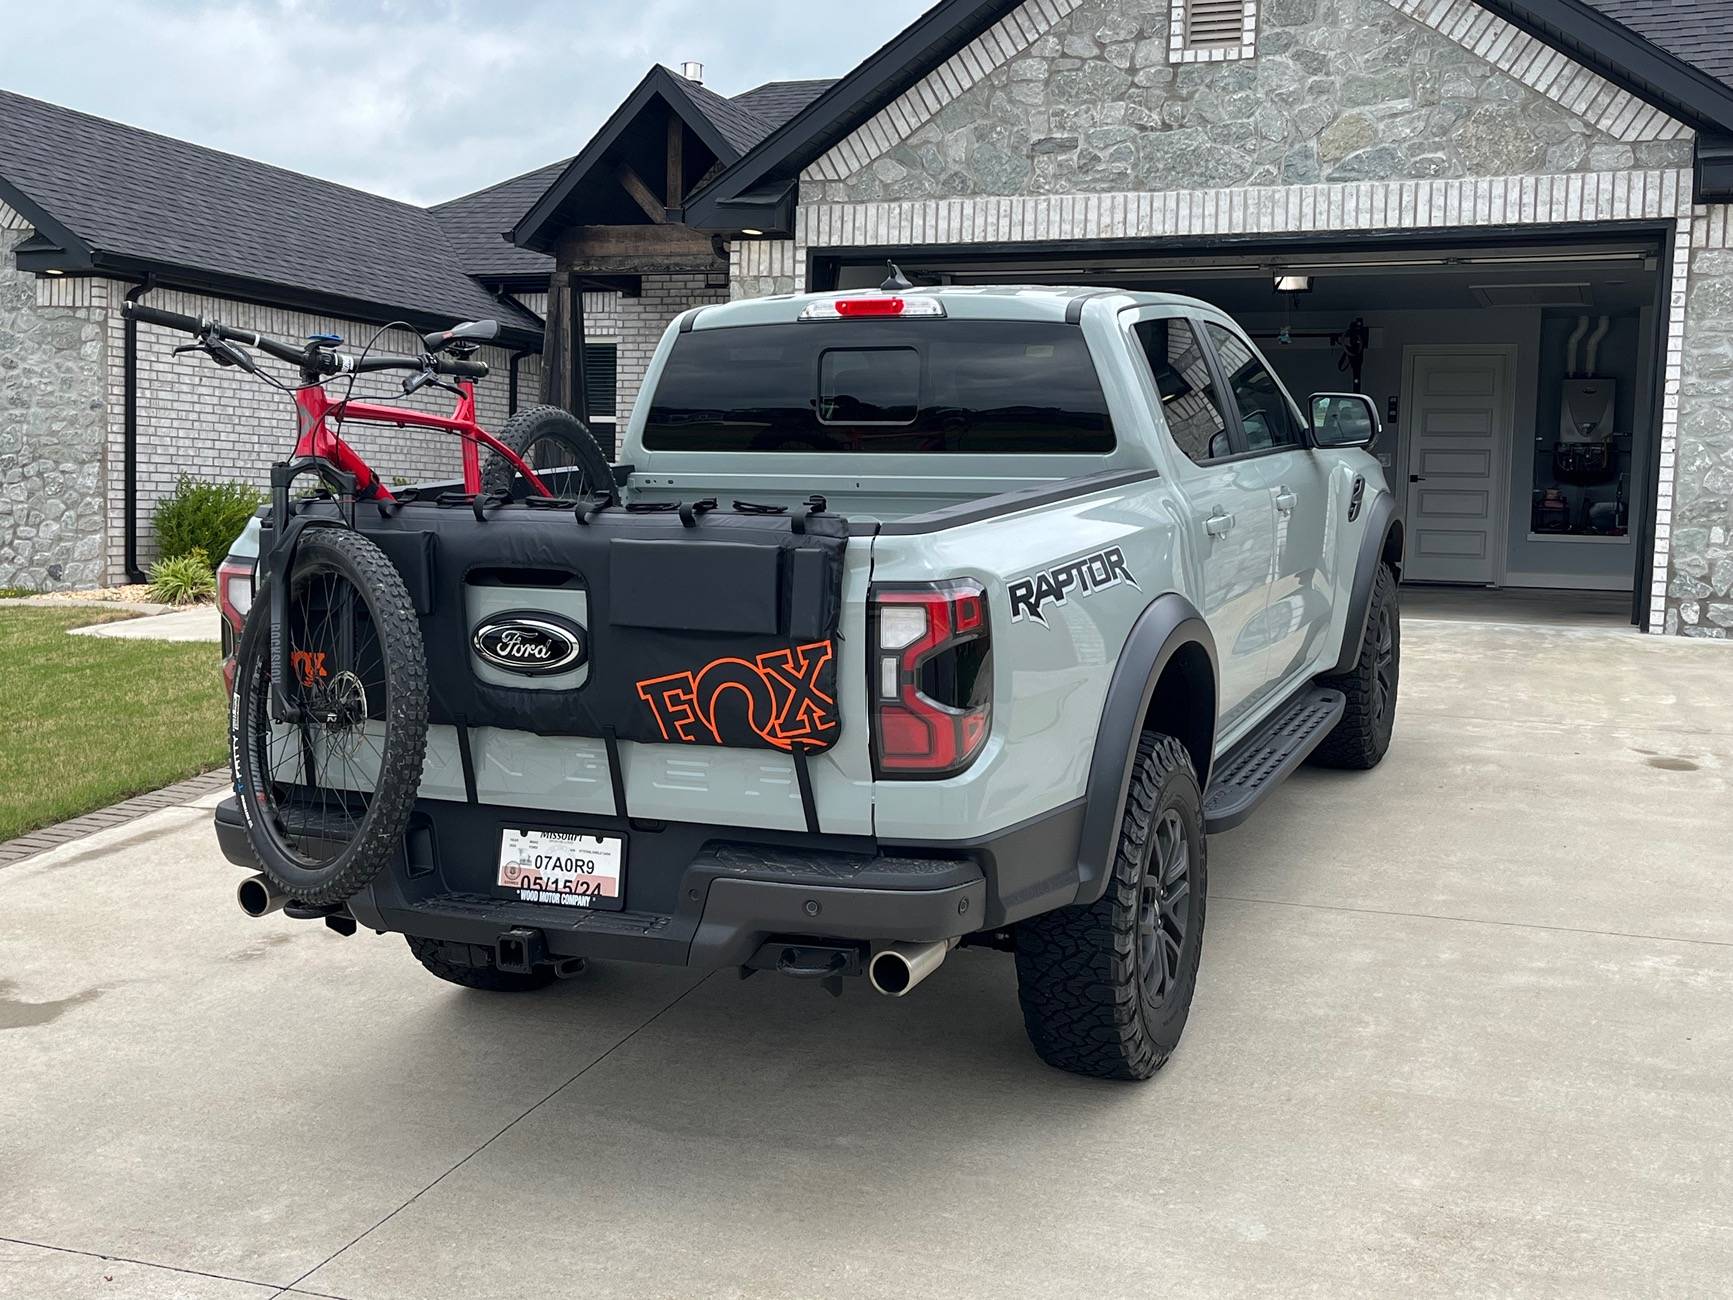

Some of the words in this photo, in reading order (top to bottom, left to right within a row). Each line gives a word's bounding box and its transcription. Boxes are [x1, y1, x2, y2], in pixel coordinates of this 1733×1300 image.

[1006, 545, 1142, 630] RAPTOR
[496, 630, 552, 659] Ford
[636, 640, 836, 751] FOX
[534, 854, 595, 875] 07A0R9
[520, 875, 603, 896] 05/15/24
[520, 890, 538, 901] WOOD
[539, 892, 560, 904] MOTOR
[561, 894, 591, 907] COMPANY
